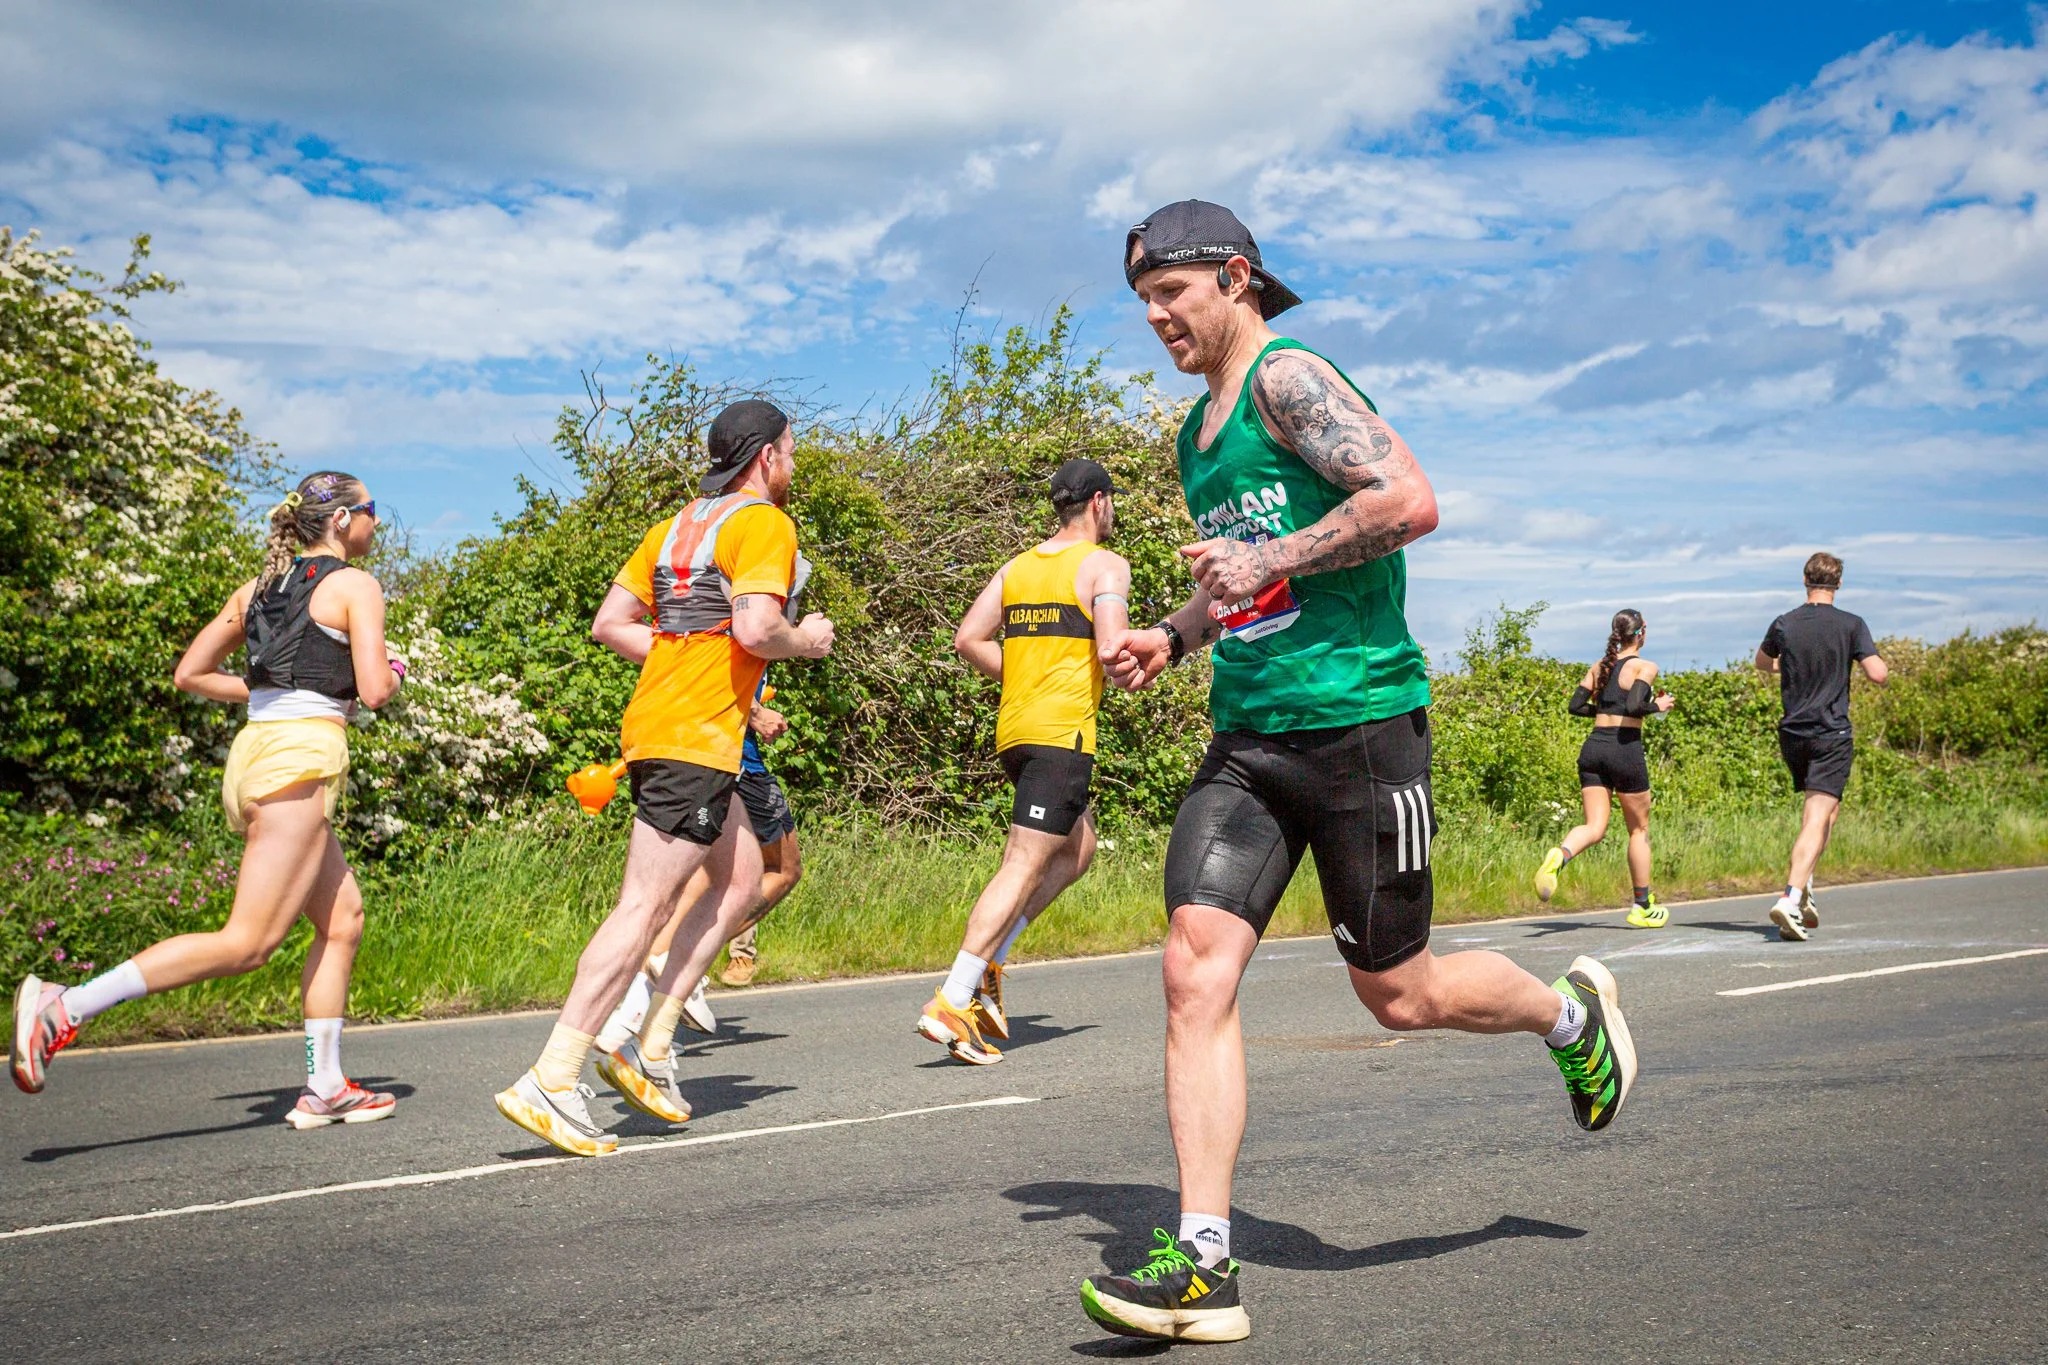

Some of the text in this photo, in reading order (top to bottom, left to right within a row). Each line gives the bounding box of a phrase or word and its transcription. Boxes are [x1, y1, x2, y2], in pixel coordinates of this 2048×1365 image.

[1201, 246, 1239, 254] TRAIL
[1193, 482, 1287, 541] ACMILLAN
[1009, 608, 1061, 624] KILBARCHAN
[1254, 623, 1279, 635] JustGiving
[304, 1035, 315, 1075] LUCKY
